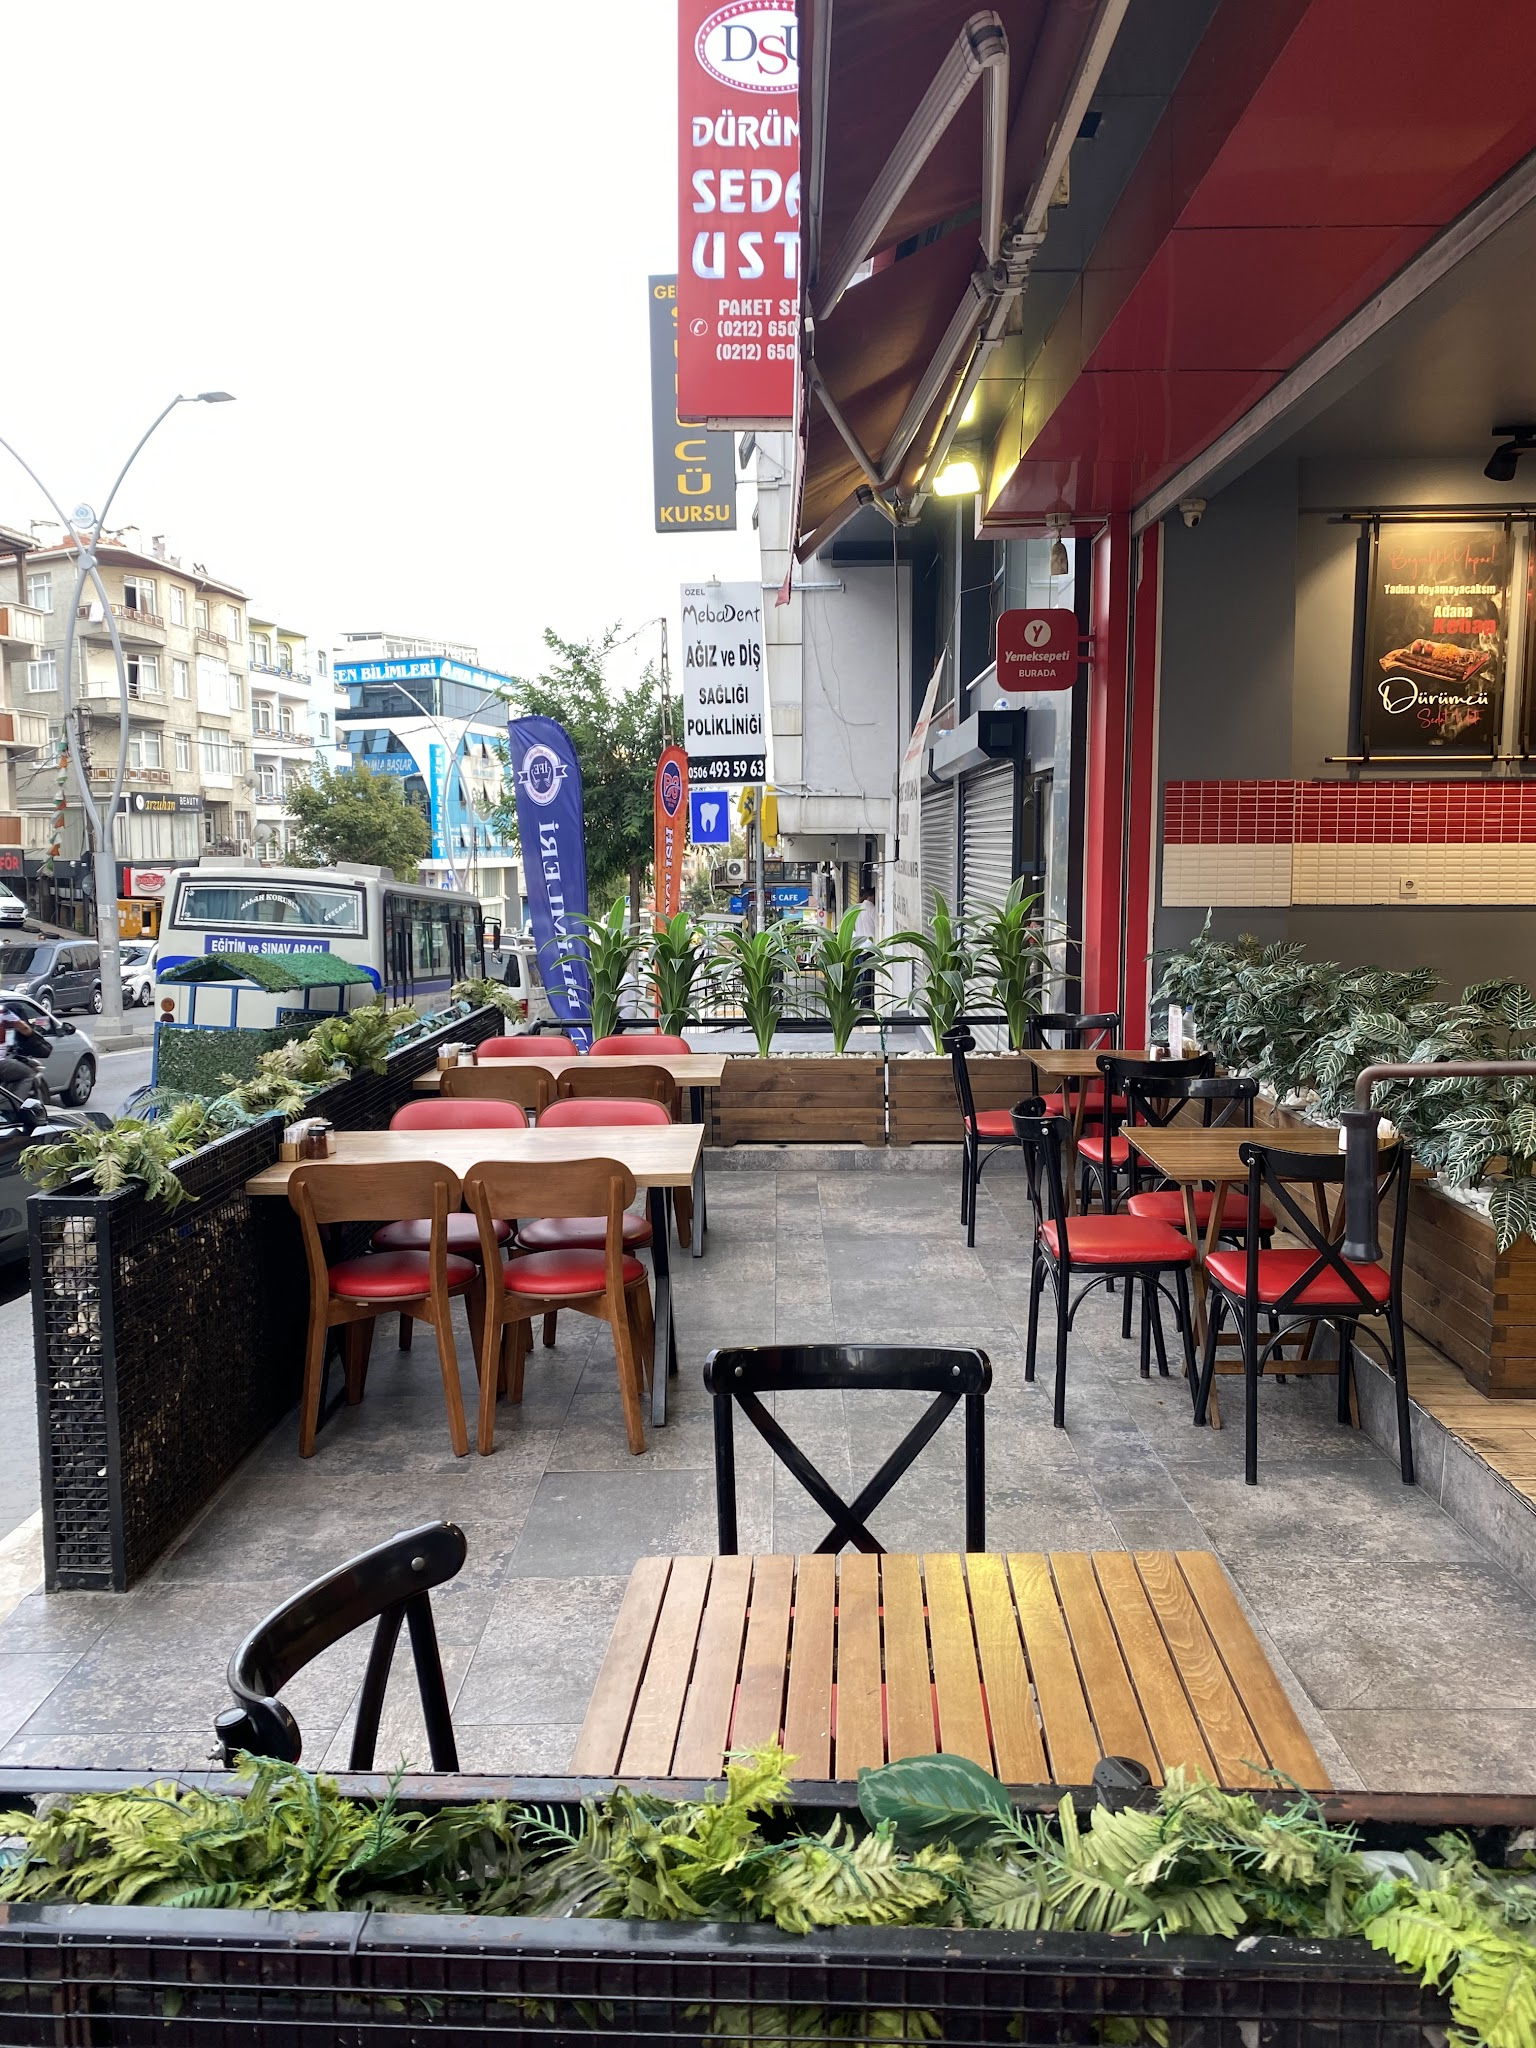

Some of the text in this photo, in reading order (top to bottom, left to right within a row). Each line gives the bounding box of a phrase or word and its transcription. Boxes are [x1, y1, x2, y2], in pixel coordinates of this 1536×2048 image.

[692, 232, 800, 279] UST
[718, 299, 773, 316] PAKET
[717, 320, 796, 338] (0212) 650
[716, 343, 795, 361] (0212) 650
[660, 504, 730, 523] KURSU
[1433, 605, 1473, 618] Adana
[1432, 618, 1497, 635] Kebap
[686, 639, 761, 671] AĞIZ ve DİŞ
[1005, 650, 1070, 663] Yemeksepeti
[361, 659, 437, 680] BİLİMLERİ
[1018, 669, 1057, 677] BURADA
[699, 684, 749, 705] SAĞLIĞI
[1377, 676, 1489, 714] Dürümcü
[687, 714, 762, 736] POLİKLİNİĞİ
[688, 759, 764, 779] 0506 493 59 63
[240, 893, 265, 912] ALLAH
[779, 894, 799, 902] CAFE
[211, 938, 246, 953] EĞİTİM
[248, 944, 259, 954] ve
[261, 942, 291, 954] SINAV
